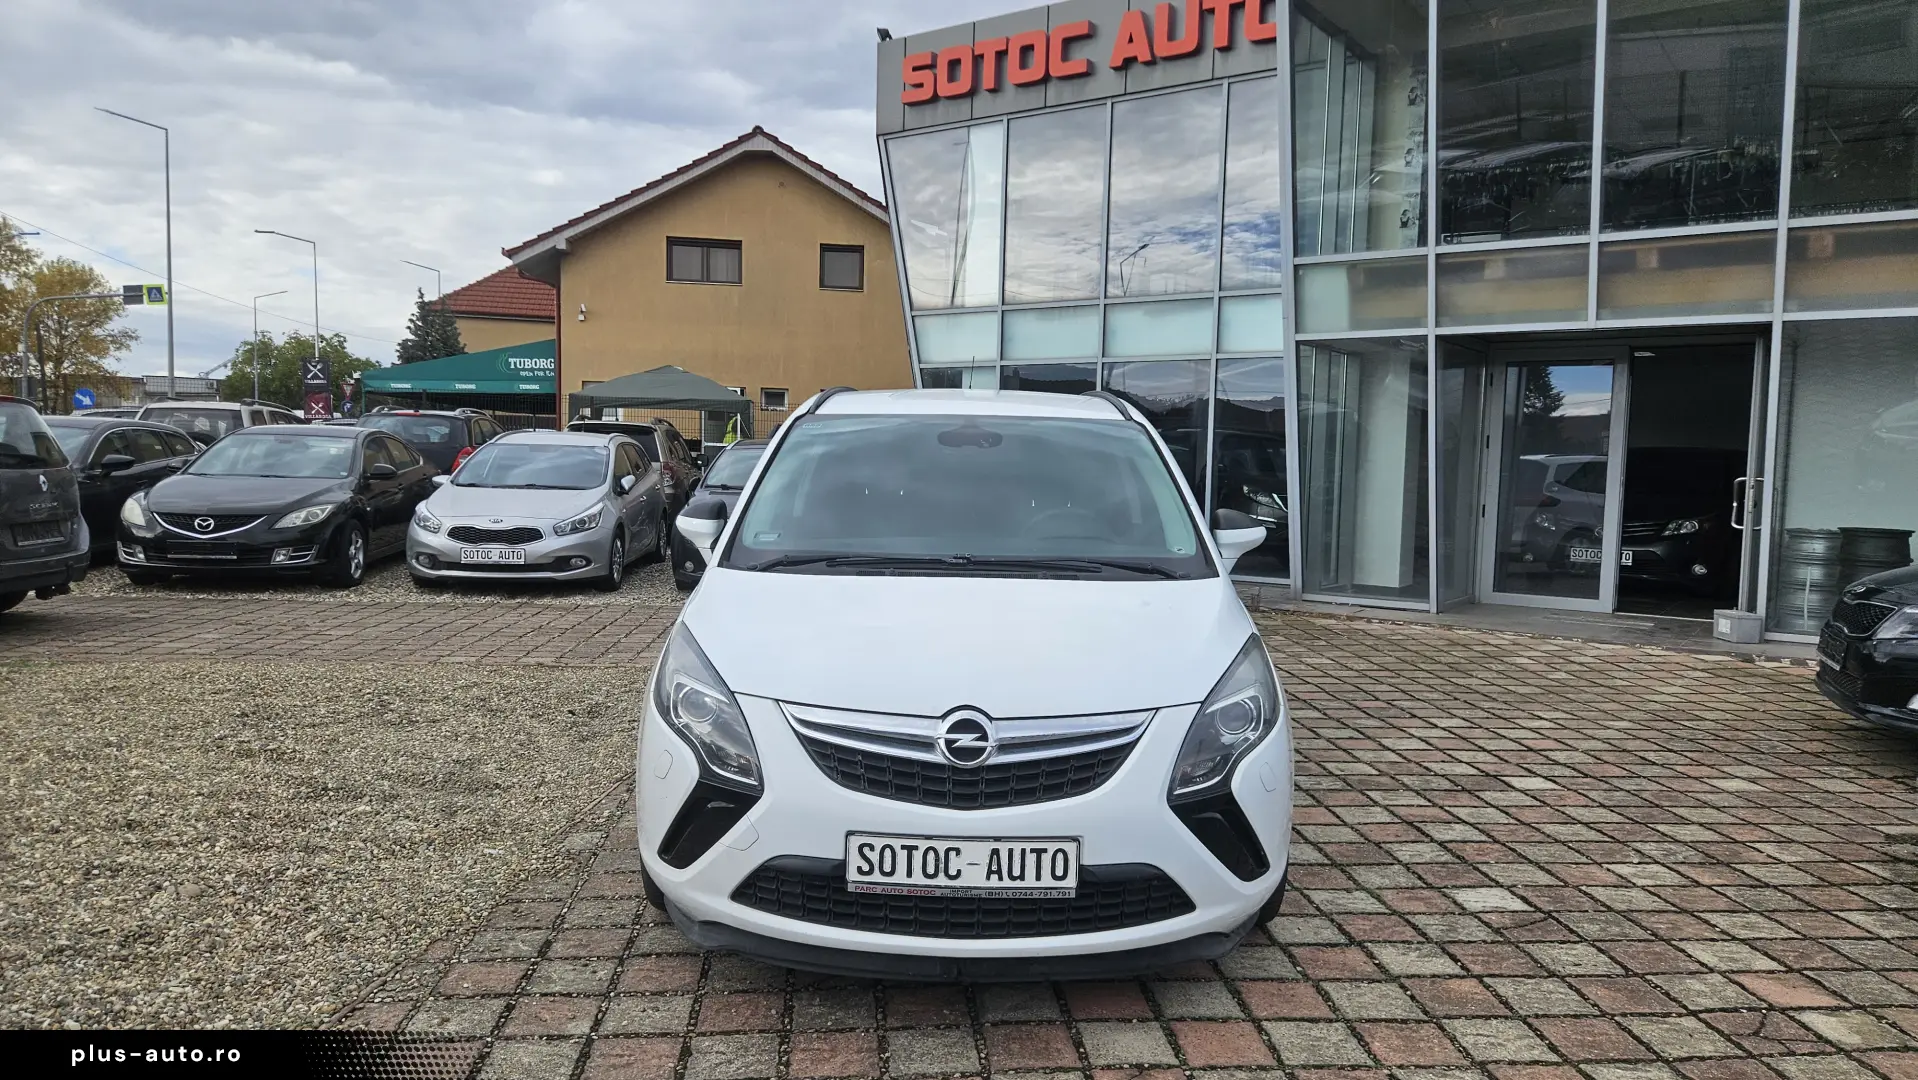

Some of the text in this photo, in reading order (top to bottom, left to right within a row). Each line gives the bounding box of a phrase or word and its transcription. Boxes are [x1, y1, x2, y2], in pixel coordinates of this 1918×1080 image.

[901, 19, 1094, 105] SOTOC
[508, 357, 555, 369] TUBORG
[854, 885, 878, 893] PARC
[906, 888, 936, 896] SOTOC
[1011, 890, 1071, 898] 0744-791.791
